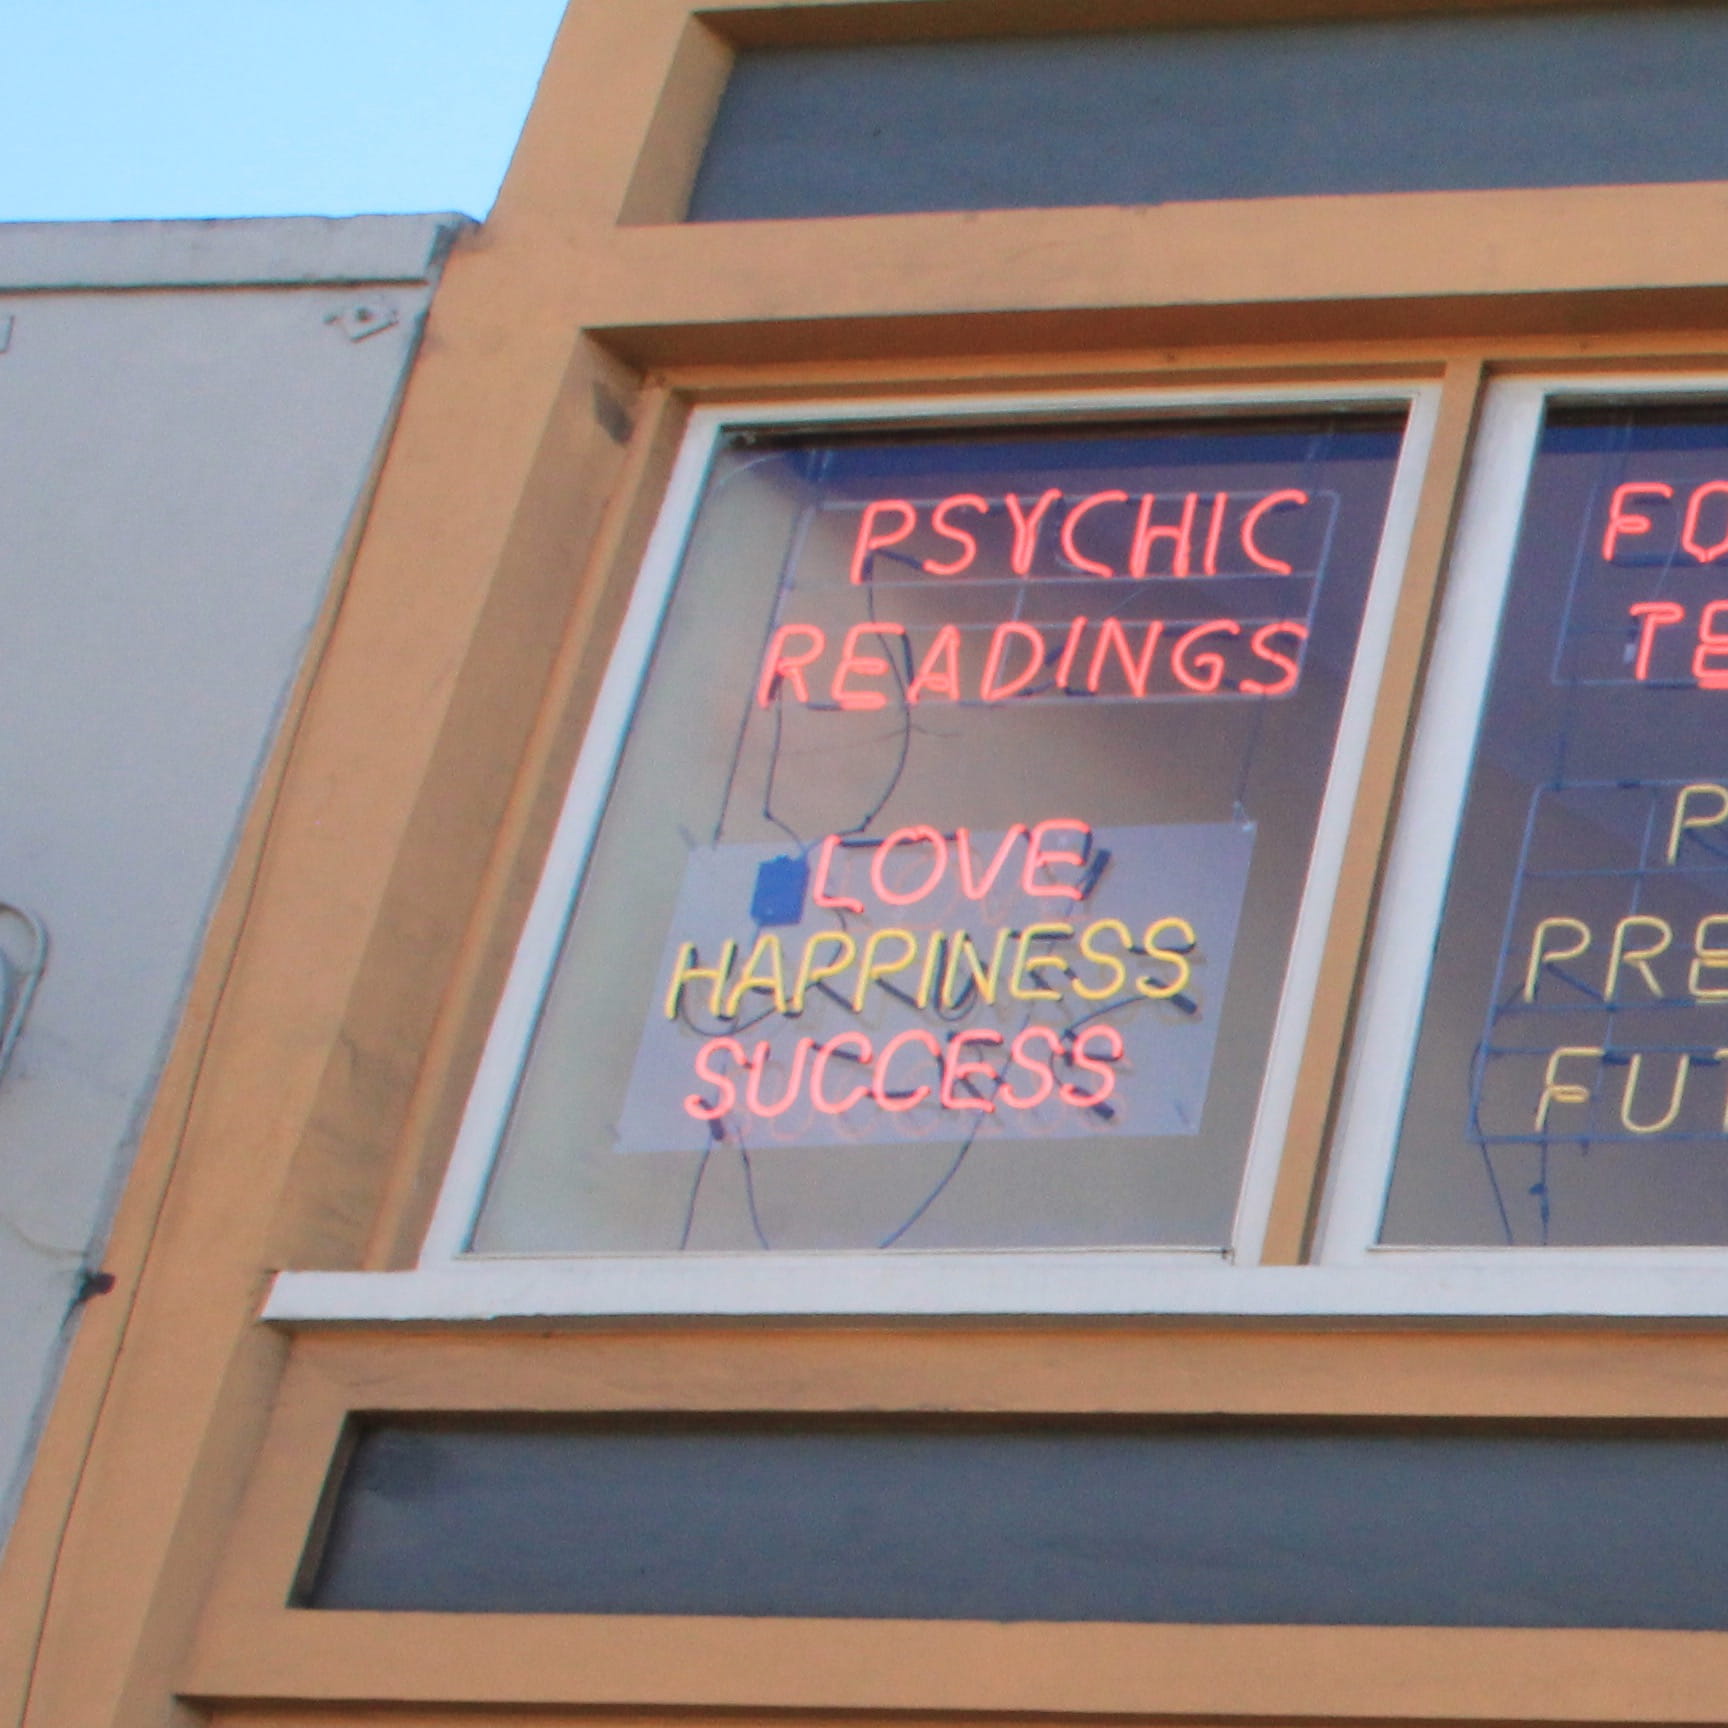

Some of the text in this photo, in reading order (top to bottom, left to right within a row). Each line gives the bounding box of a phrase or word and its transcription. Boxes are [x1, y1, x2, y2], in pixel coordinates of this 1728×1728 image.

[850, 489, 1308, 584] PSYCHIC
[757, 617, 1310, 710] READINGS
[813, 818, 1092, 913] LOVE
[664, 917, 1197, 1021] HAPPINESS
[684, 1024, 1125, 1120] SUCCESS
